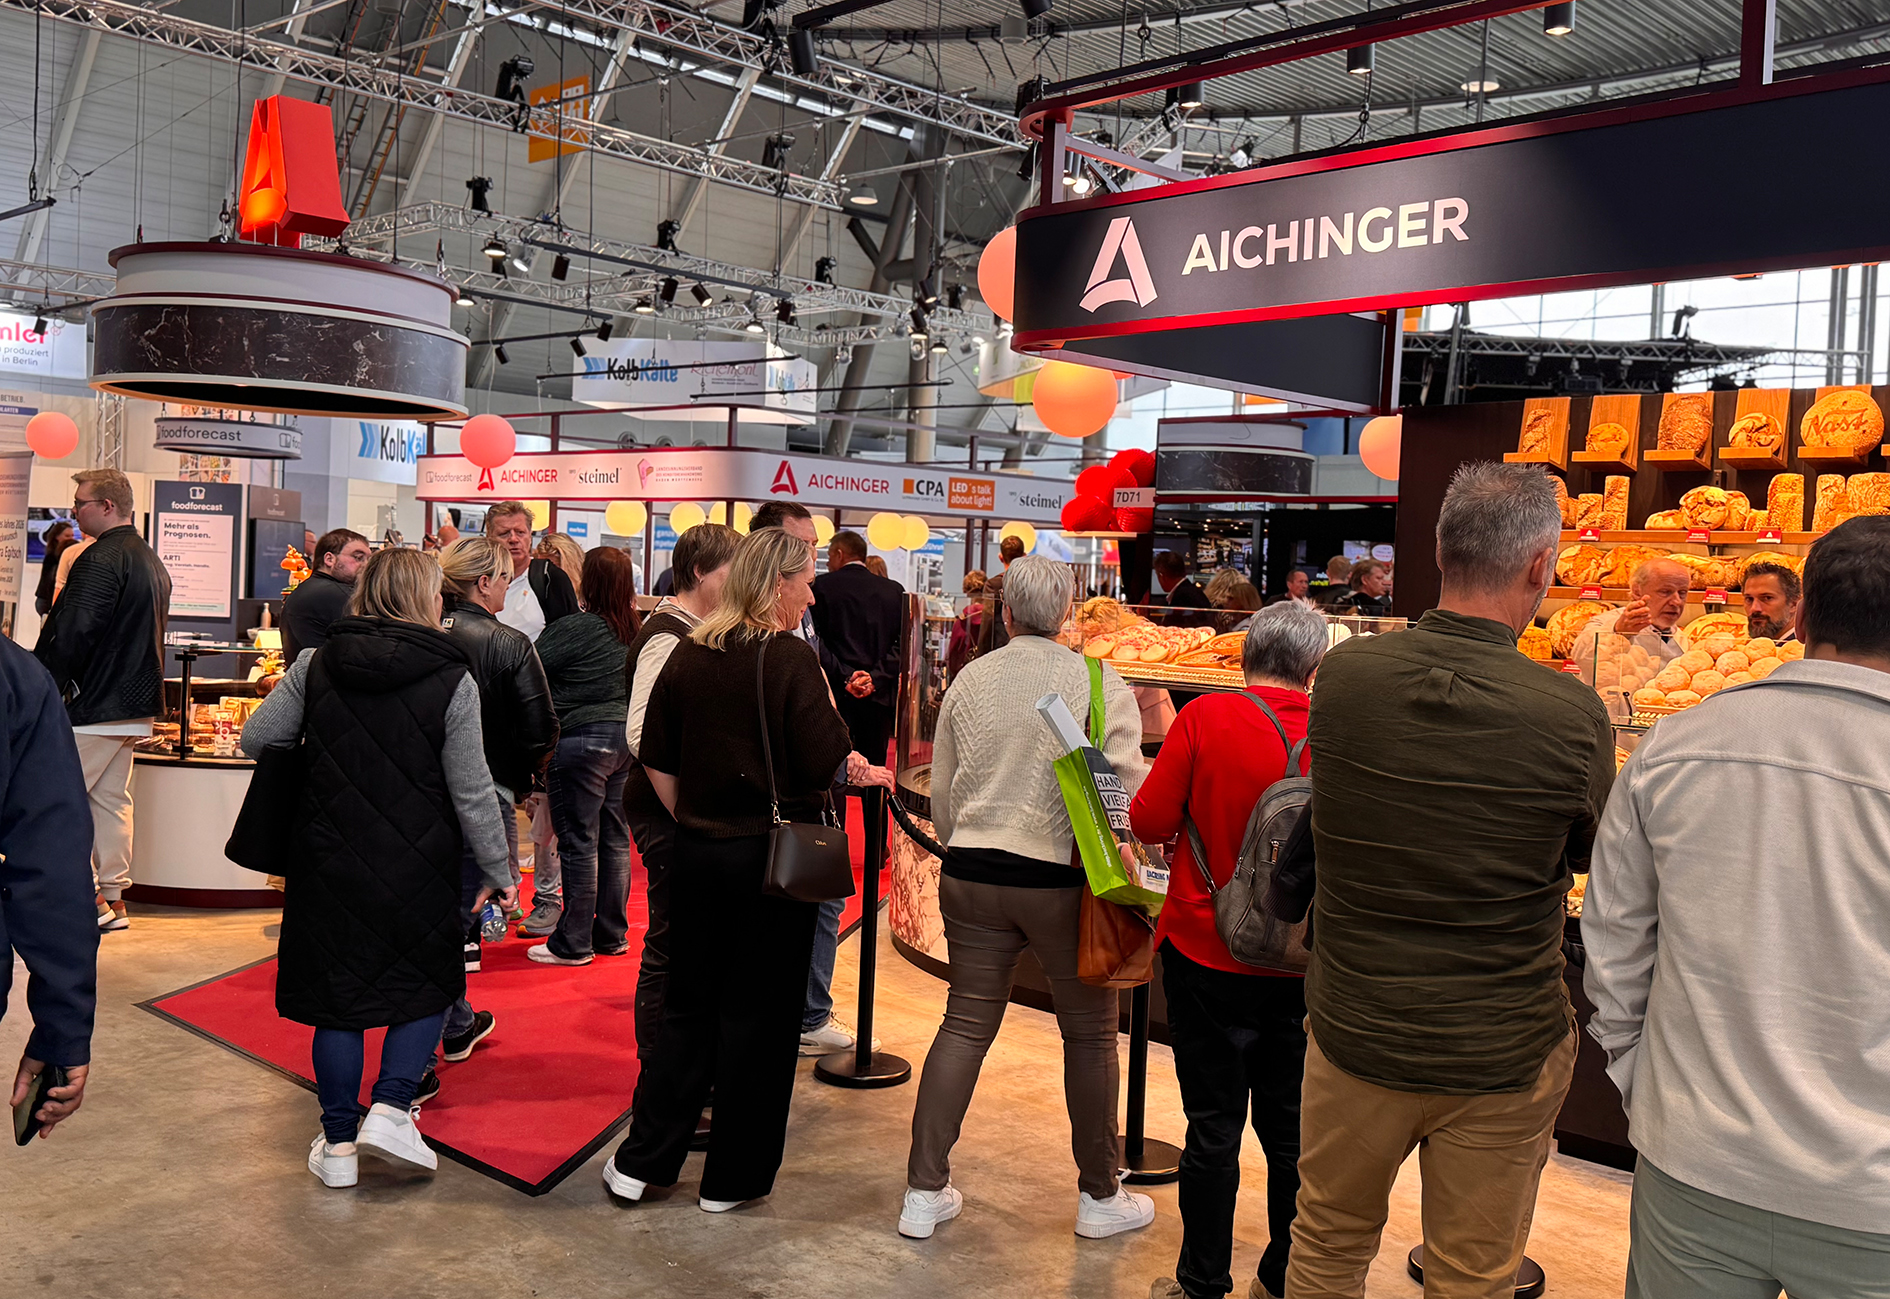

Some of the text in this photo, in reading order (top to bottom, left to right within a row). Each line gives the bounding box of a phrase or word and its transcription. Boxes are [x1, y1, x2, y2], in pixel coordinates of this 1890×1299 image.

[1181, 197, 1469, 275] AICHINGER
[4, 347, 49, 357] produziert
[2, 355, 38, 366] in Berlin
[607, 357, 678, 383] KolbKälte
[161, 425, 242, 442] foodforecast
[381, 425, 426, 465] KolbKäl
[434, 472, 472, 482] foodforecast
[500, 469, 558, 483] AICHINGER
[578, 467, 619, 484] steimel
[808, 474, 890, 494] AICHINGER
[916, 480, 944, 497] CPA
[952, 482, 968, 493] LED
[978, 485, 991, 495] talk
[951, 494, 992, 508] about light!
[1019, 493, 1062, 510] steimel
[1116, 491, 1141, 503] 7D71
[171, 500, 223, 511] foodforecast
[164, 522, 185, 530] Mehr
[164, 530, 211, 540] Prognosen.
[1096, 775, 1121, 789] HAND
